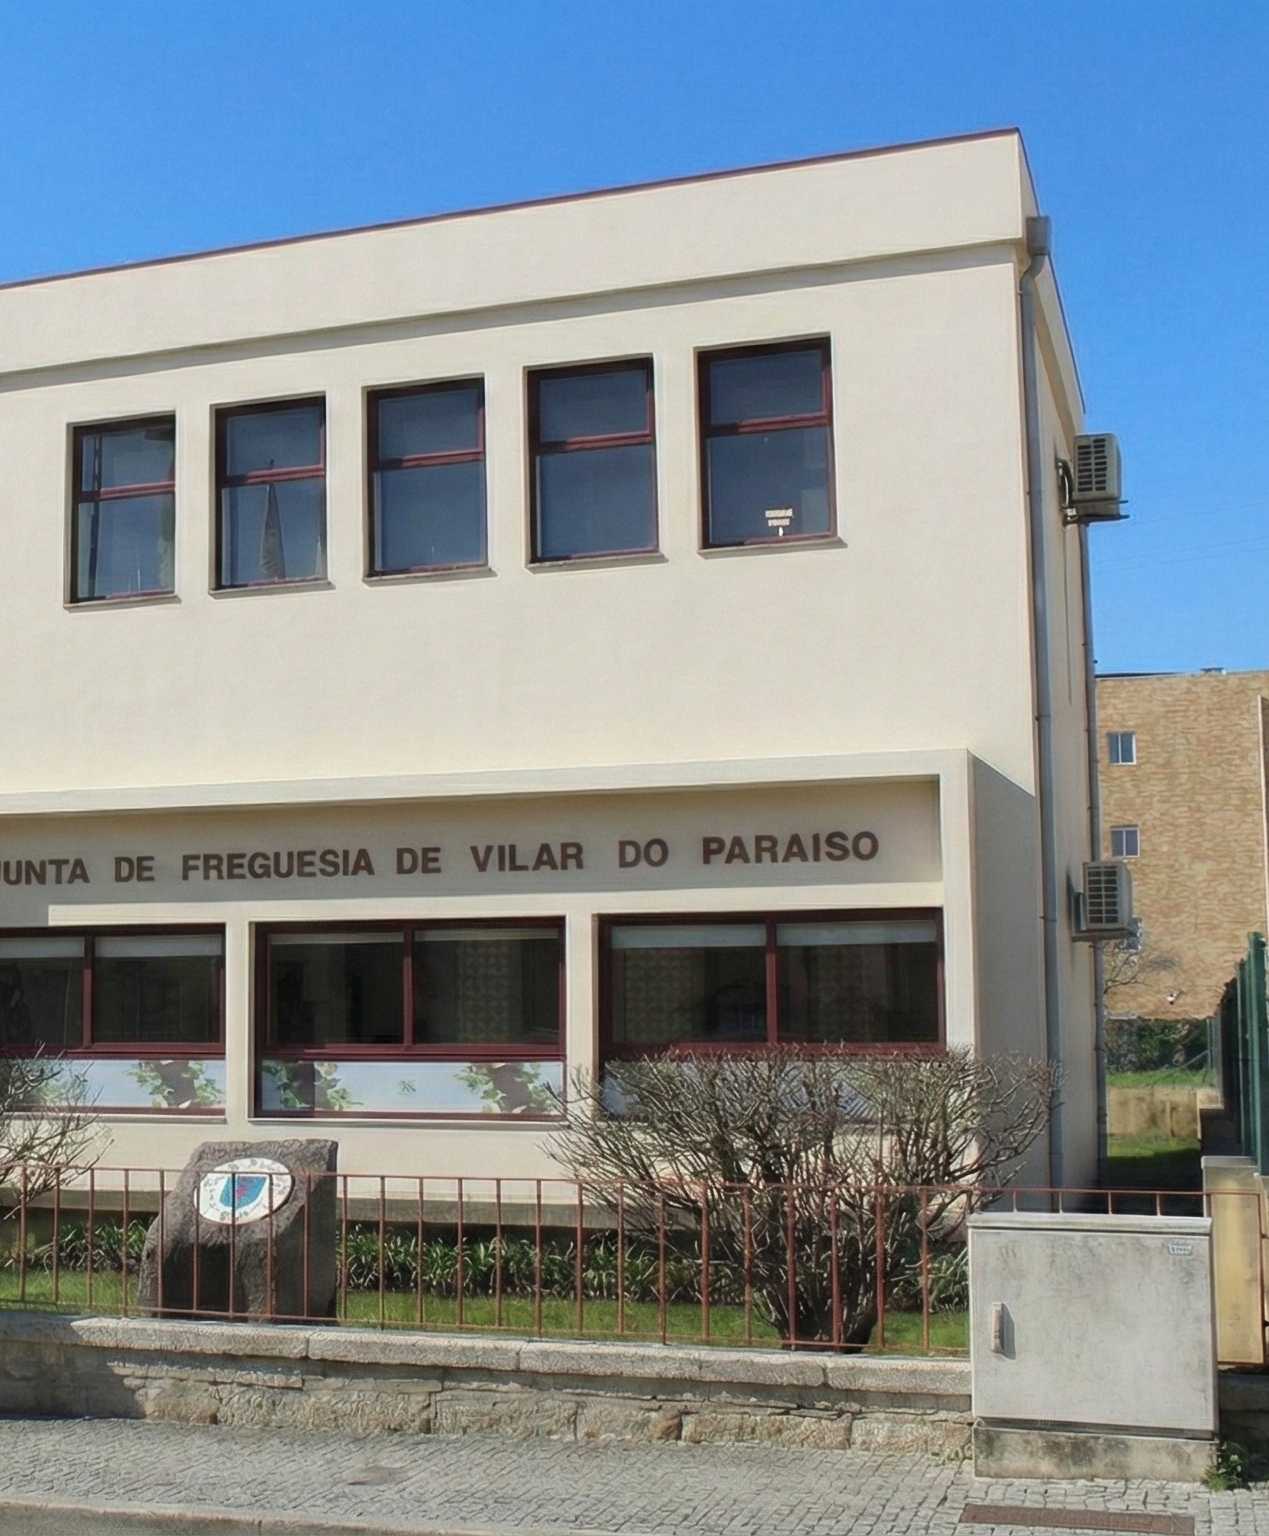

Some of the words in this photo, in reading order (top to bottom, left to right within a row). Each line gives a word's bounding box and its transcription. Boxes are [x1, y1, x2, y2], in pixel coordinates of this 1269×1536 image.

[114, 855, 155, 883] DE
[181, 848, 376, 881] FREGUESIA
[396, 846, 442, 875] DE
[470, 842, 584, 873] VILAR
[618, 838, 669, 869] DO
[702, 830, 880, 865] PARAISO
